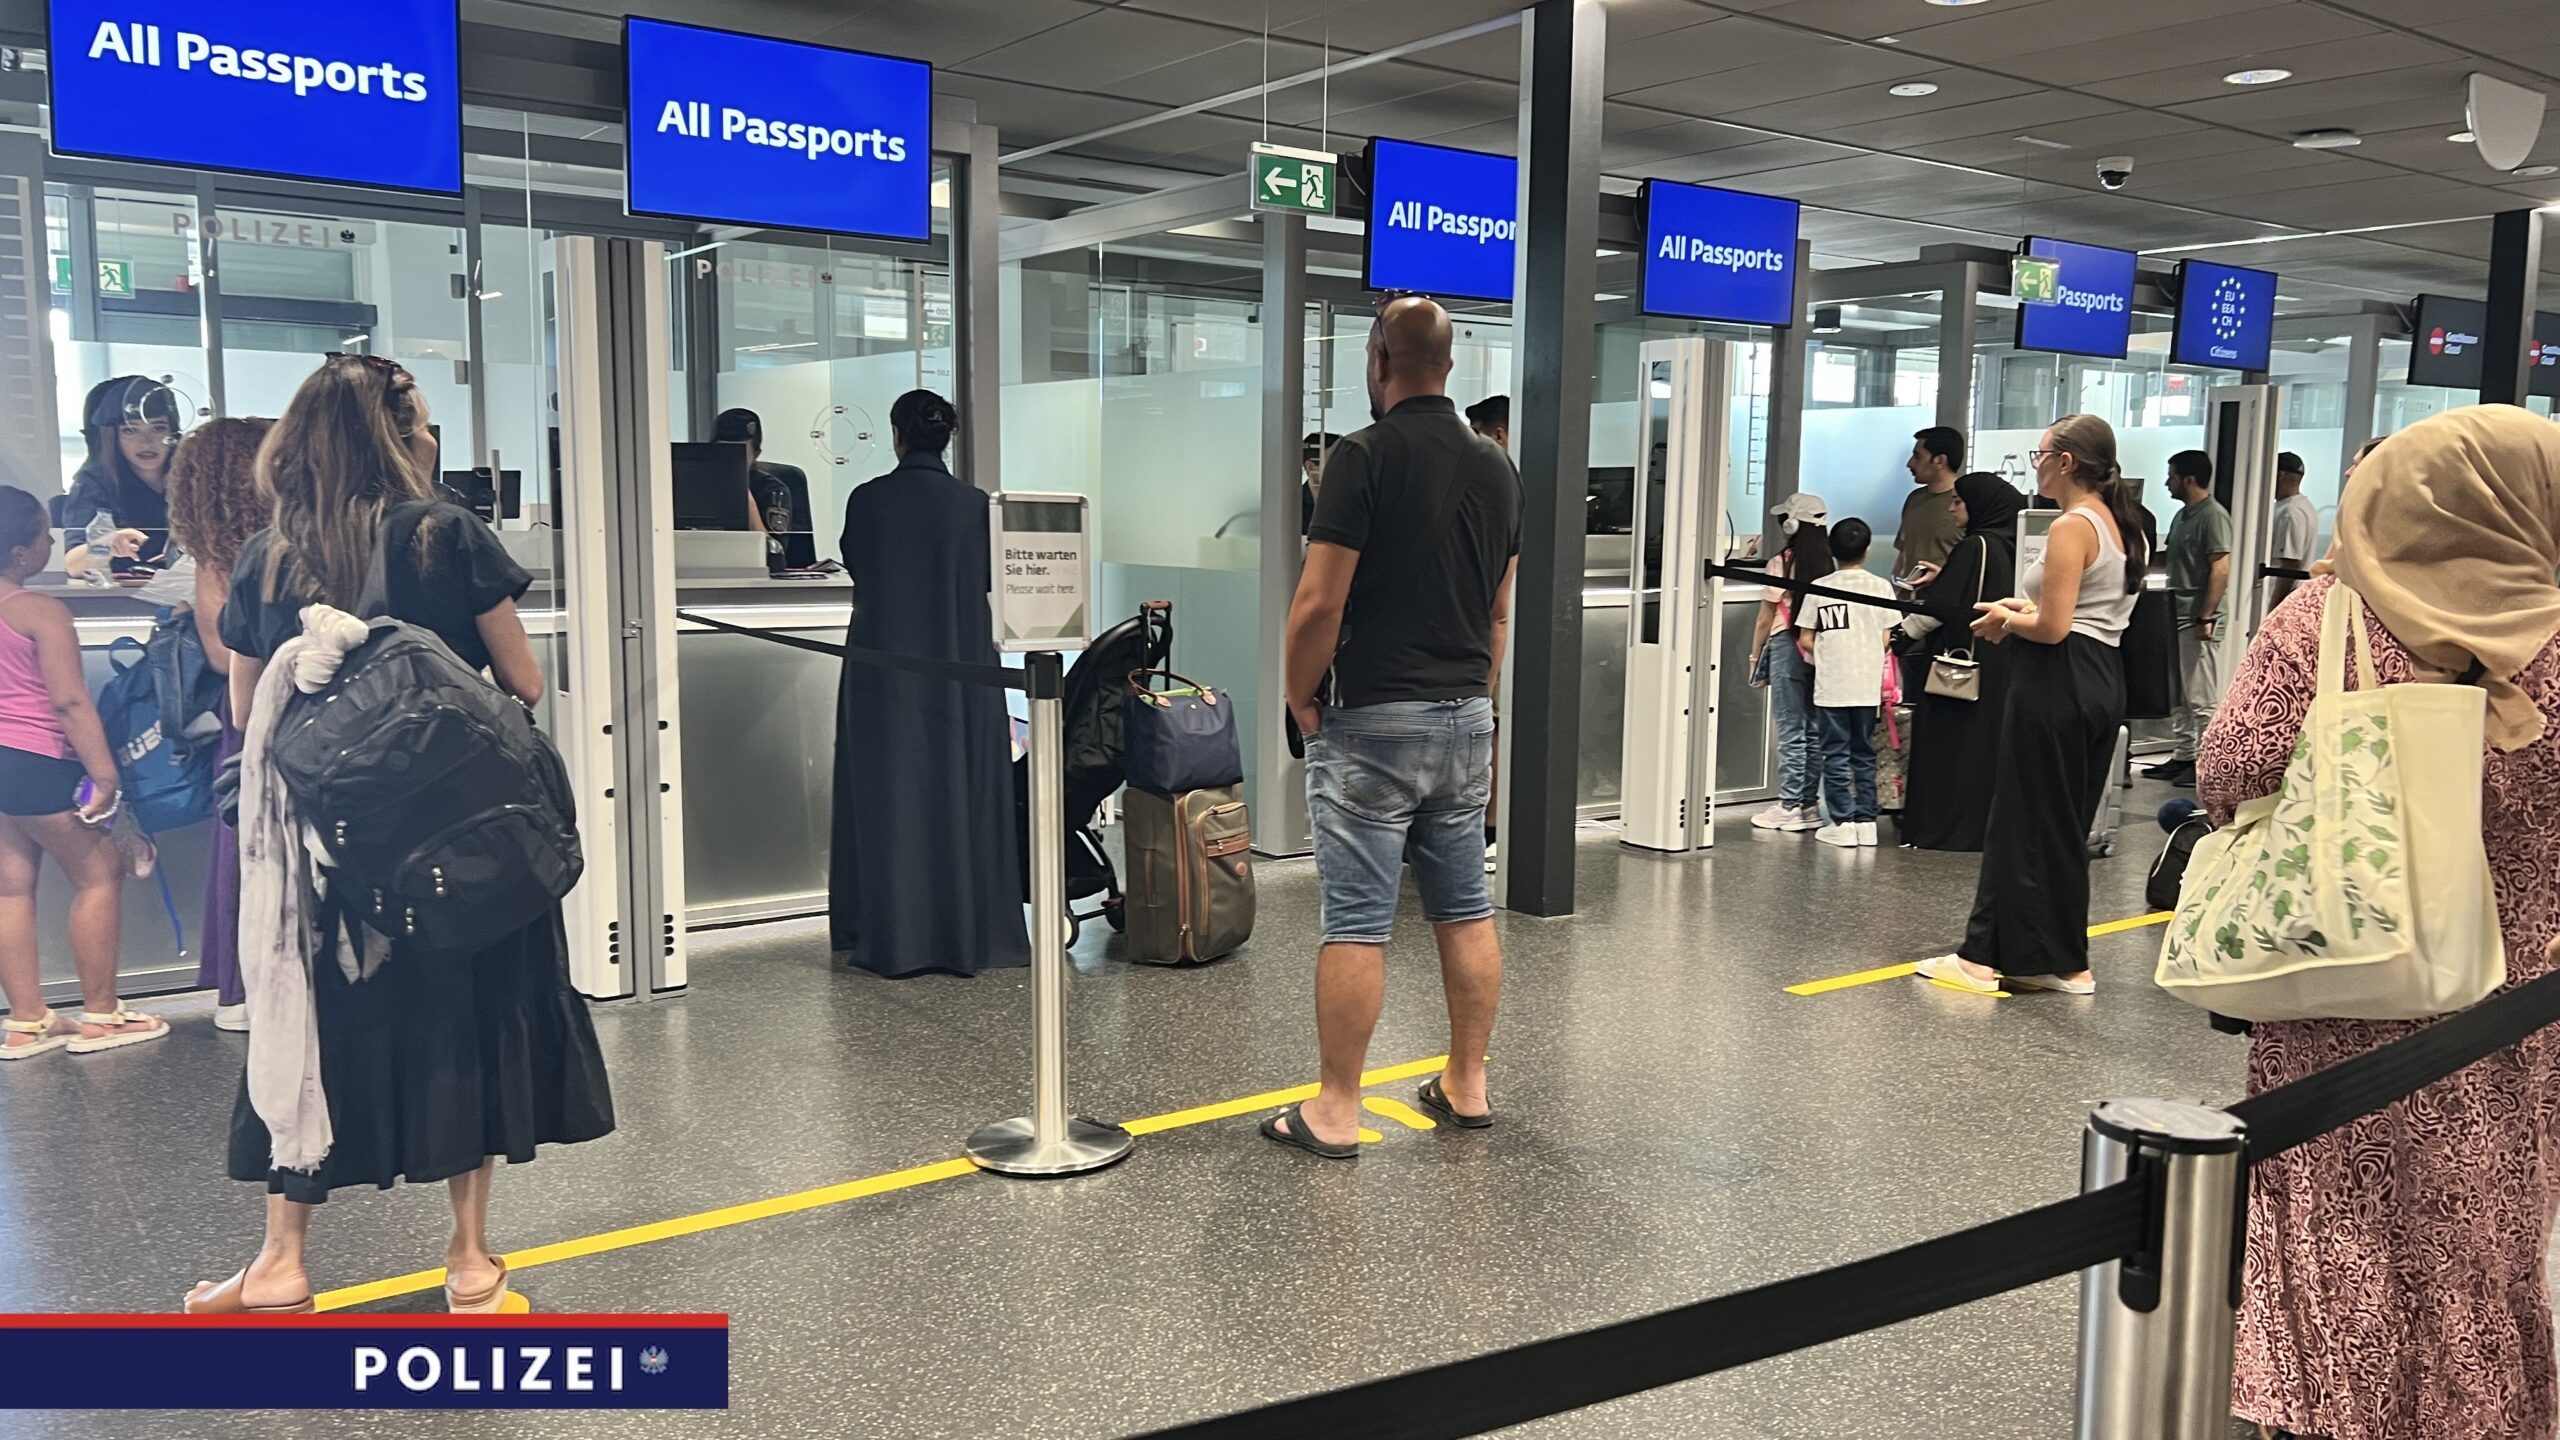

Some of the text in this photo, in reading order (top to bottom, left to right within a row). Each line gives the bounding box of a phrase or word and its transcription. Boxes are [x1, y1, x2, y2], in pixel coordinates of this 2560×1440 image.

[88, 21, 427, 102] All Passports
[657, 100, 906, 163] All Passports
[172, 212, 330, 249] POLIZEI
[1387, 201, 1517, 245] All Passpor
[1658, 235, 1783, 273] All Passports
[696, 258, 815, 290] POLIZEI
[2057, 285, 2124, 314] Passports
[2221, 302, 2235, 315] EEA
[2224, 290, 2235, 302] EU
[2221, 315, 2233, 327] CH
[1005, 548, 1077, 561] Bitte warten
[1005, 564, 1050, 576] Sie hier.
[1006, 584, 1076, 594] Please wait here.
[1819, 603, 1847, 630] NY
